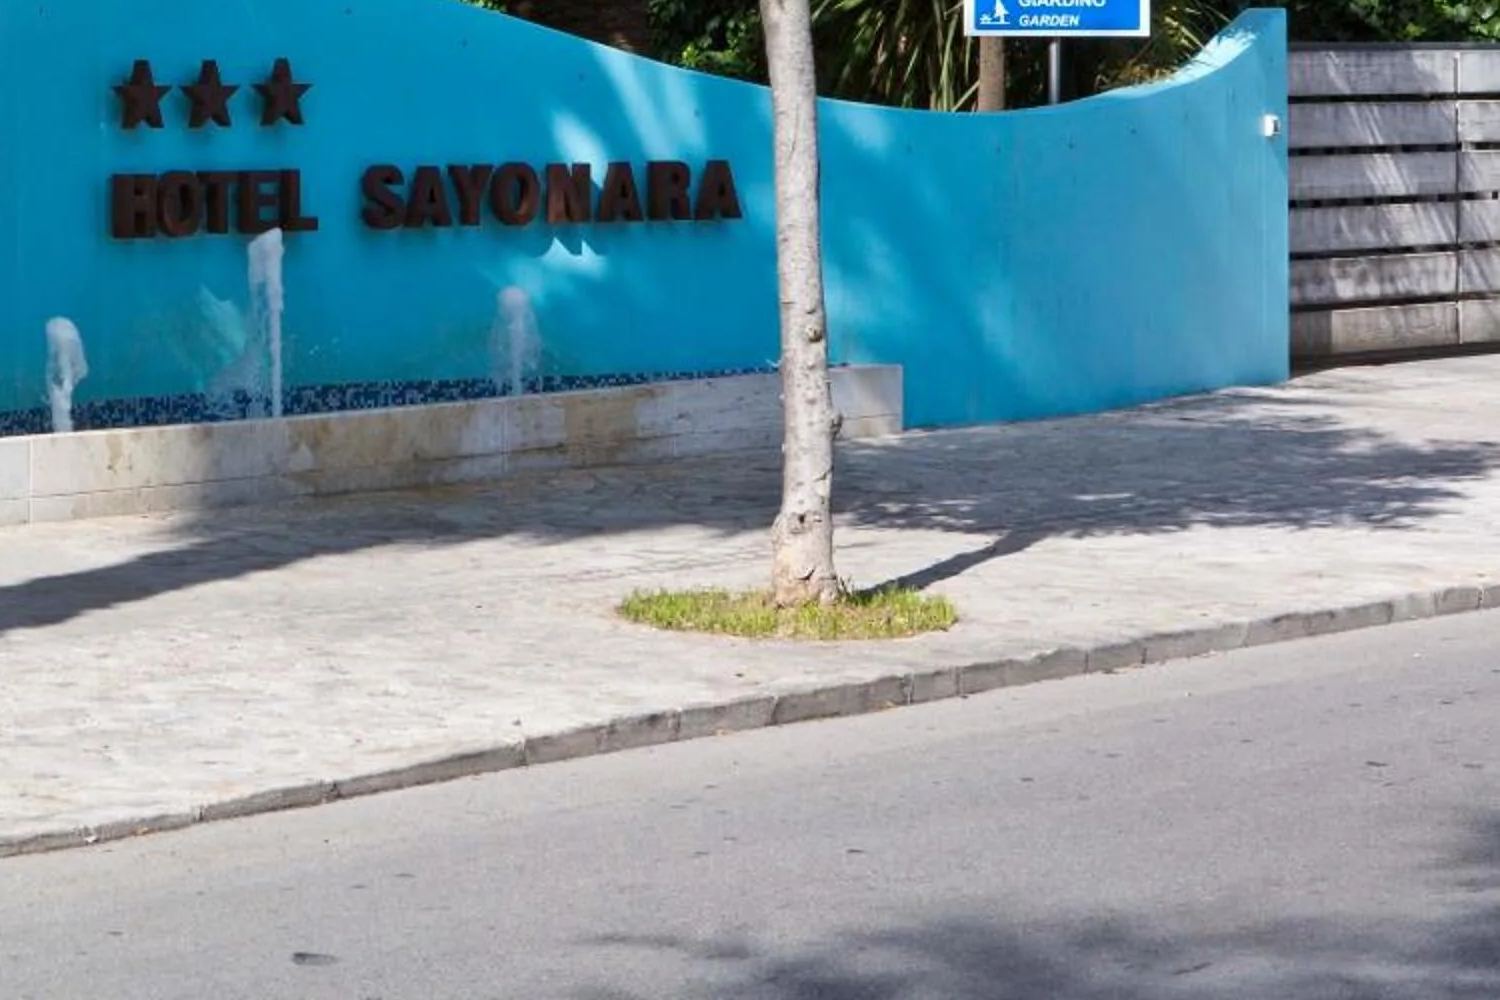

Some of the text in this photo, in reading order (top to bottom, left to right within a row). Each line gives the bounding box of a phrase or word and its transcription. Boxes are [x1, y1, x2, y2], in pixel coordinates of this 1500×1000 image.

[1019, 14, 1080, 27] GARDEN
[111, 160, 742, 239] HOTEL SAYONARA
